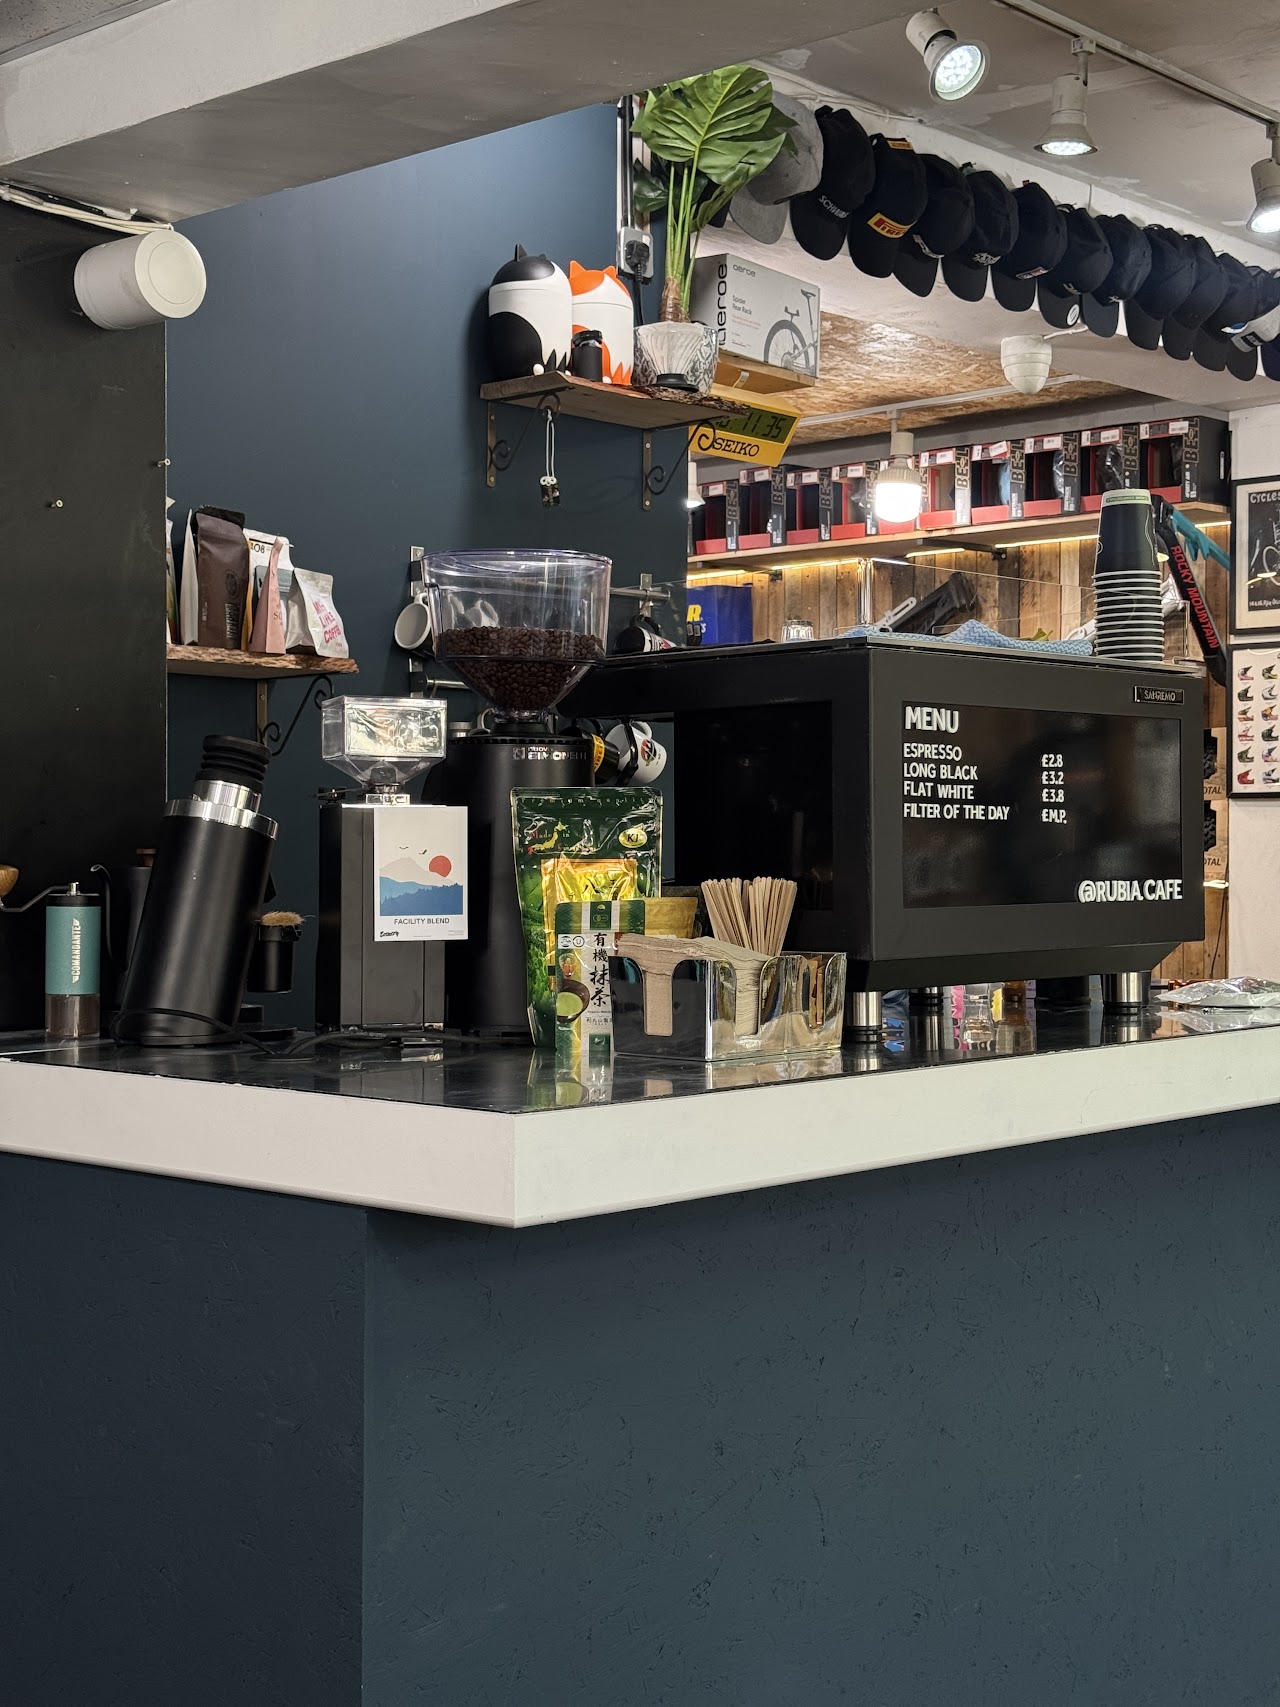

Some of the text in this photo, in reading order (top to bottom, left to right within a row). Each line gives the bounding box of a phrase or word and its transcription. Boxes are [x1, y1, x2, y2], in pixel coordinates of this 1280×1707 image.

[733, 264, 756, 278] aeroe
[713, 437, 760, 457] SEIKO
[1171, 545, 1220, 649] ROCKY MOUNTAIN
[1144, 690, 1176, 701] SANREMO
[905, 706, 959, 733] MENU
[903, 743, 962, 761] ESPRESSO
[1041, 754, 1063, 768] £2.8
[903, 762, 978, 780] LONG BLACK
[1041, 771, 1064, 785] £3.2
[903, 781, 975, 799] FLAT WHITE
[1041, 788, 1065, 803] £3.8
[903, 803, 1010, 820] FILTER OF THE DAY
[427, 917, 450, 925] BLEND
[71, 925, 81, 977] COMANDANTE
